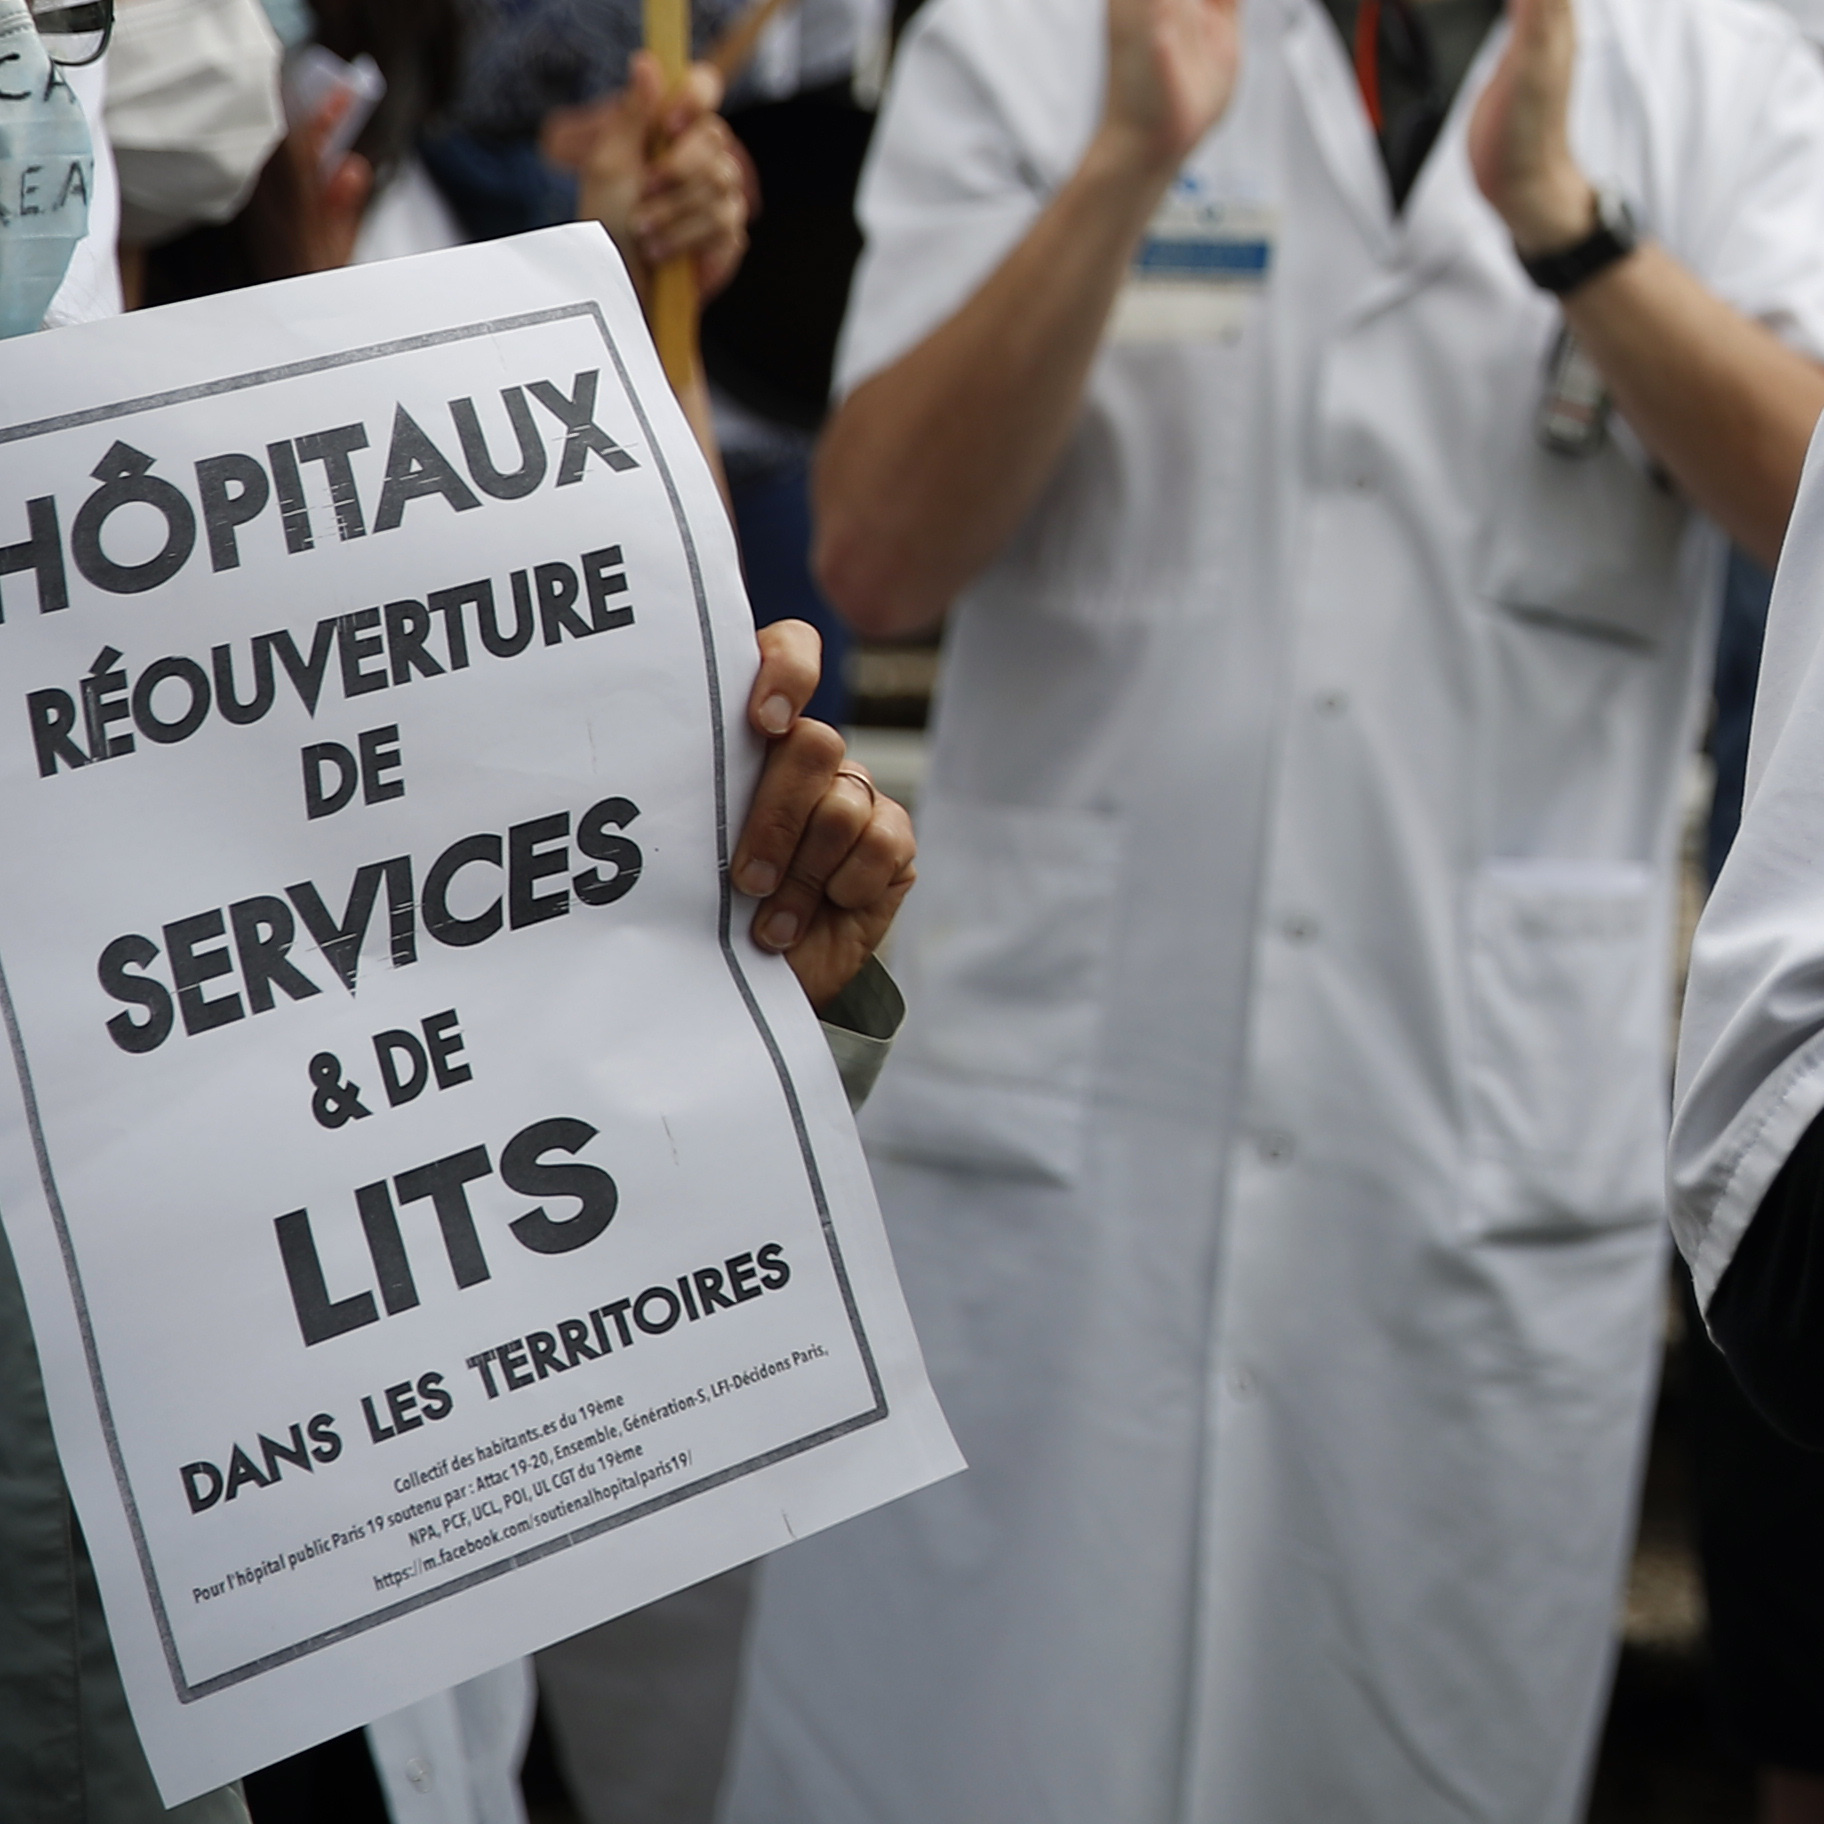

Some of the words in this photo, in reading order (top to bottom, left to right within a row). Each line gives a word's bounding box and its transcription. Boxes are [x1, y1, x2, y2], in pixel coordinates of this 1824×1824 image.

[26, 544, 634, 778] RÉOUVERTURE
[301, 723, 406, 820] DE
[97, 797, 642, 1054] SERVICES
[309, 1051, 372, 1129] &
[373, 1008, 473, 1108] DE
[274, 1116, 619, 1348] LITS
[179, 1412, 342, 1515] DANS
[361, 1371, 453, 1444] LES
[466, 1242, 791, 1399] TERRITOIRES
[192, 1581, 225, 1604] Pour
[287, 1538, 332, 1571] public
[330, 1524, 366, 1549] Paris
[366, 1515, 384, 1534] 19
[386, 1496, 443, 1527] soutenu
[476, 1469, 510, 1492] Attac
[509, 1450, 554, 1477] 19-20,
[553, 1425, 623, 1460] Ensemble,
[791, 1343, 829, 1366] Paris,
[393, 1458, 449, 1494] Collectif
[451, 1453, 476, 1472] des
[559, 1413, 578, 1429] du
[578, 1395, 624, 1420] 19ème
[408, 1524, 442, 1547] NPA,
[441, 1511, 472, 1534] PCF,
[471, 1500, 503, 1522] UCL,
[532, 1479, 552, 1497] UL
[551, 1467, 576, 1490] CGT
[577, 1463, 597, 1479] du
[597, 1444, 644, 1470] 19ème
